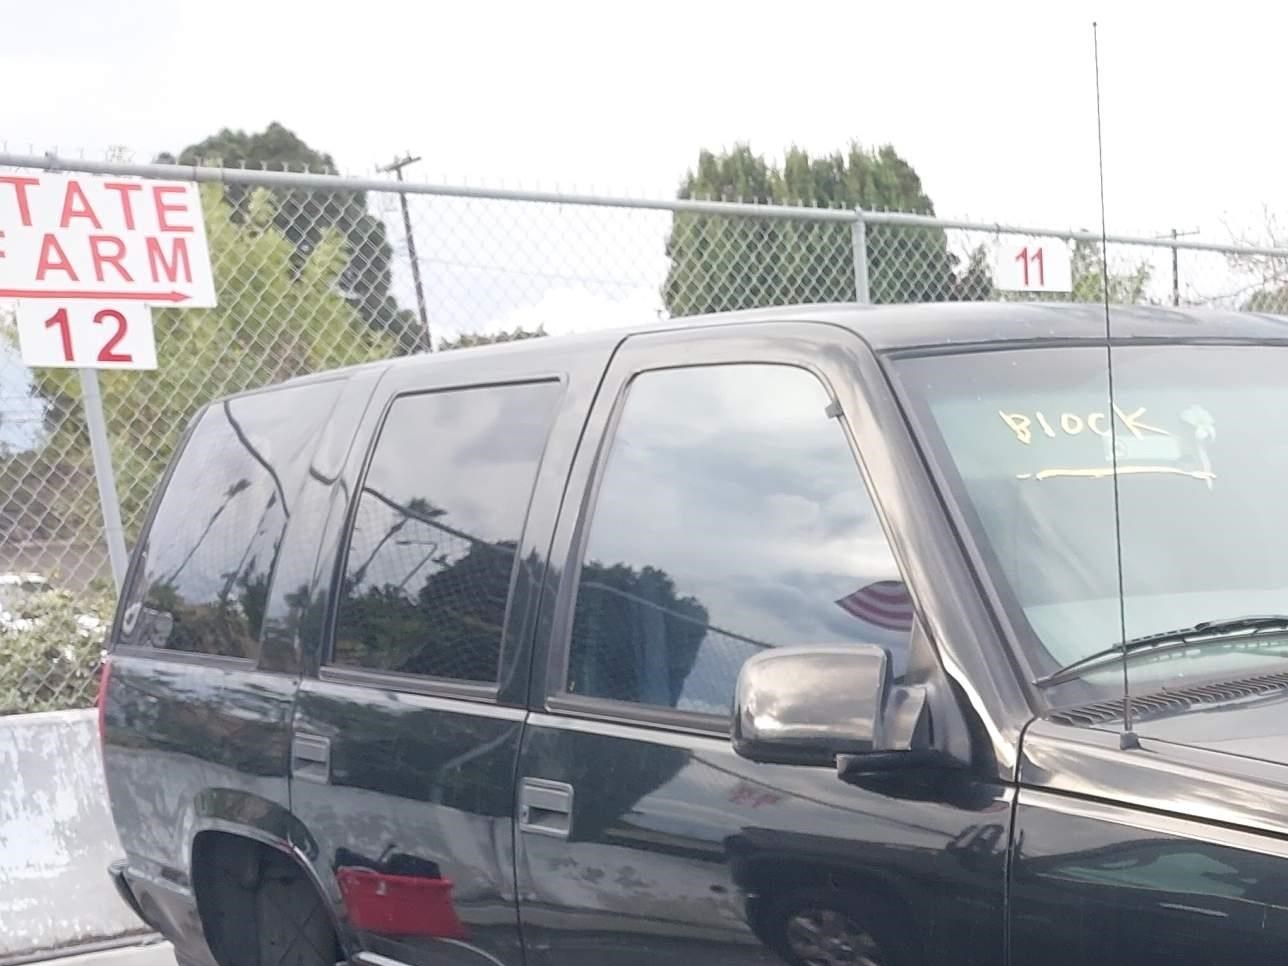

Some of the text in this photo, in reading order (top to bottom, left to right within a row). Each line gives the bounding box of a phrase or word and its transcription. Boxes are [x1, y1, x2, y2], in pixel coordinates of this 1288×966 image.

[0, 231, 193, 283] ARM
[1016, 247, 1044, 286] 11
[45, 308, 133, 362] 12
